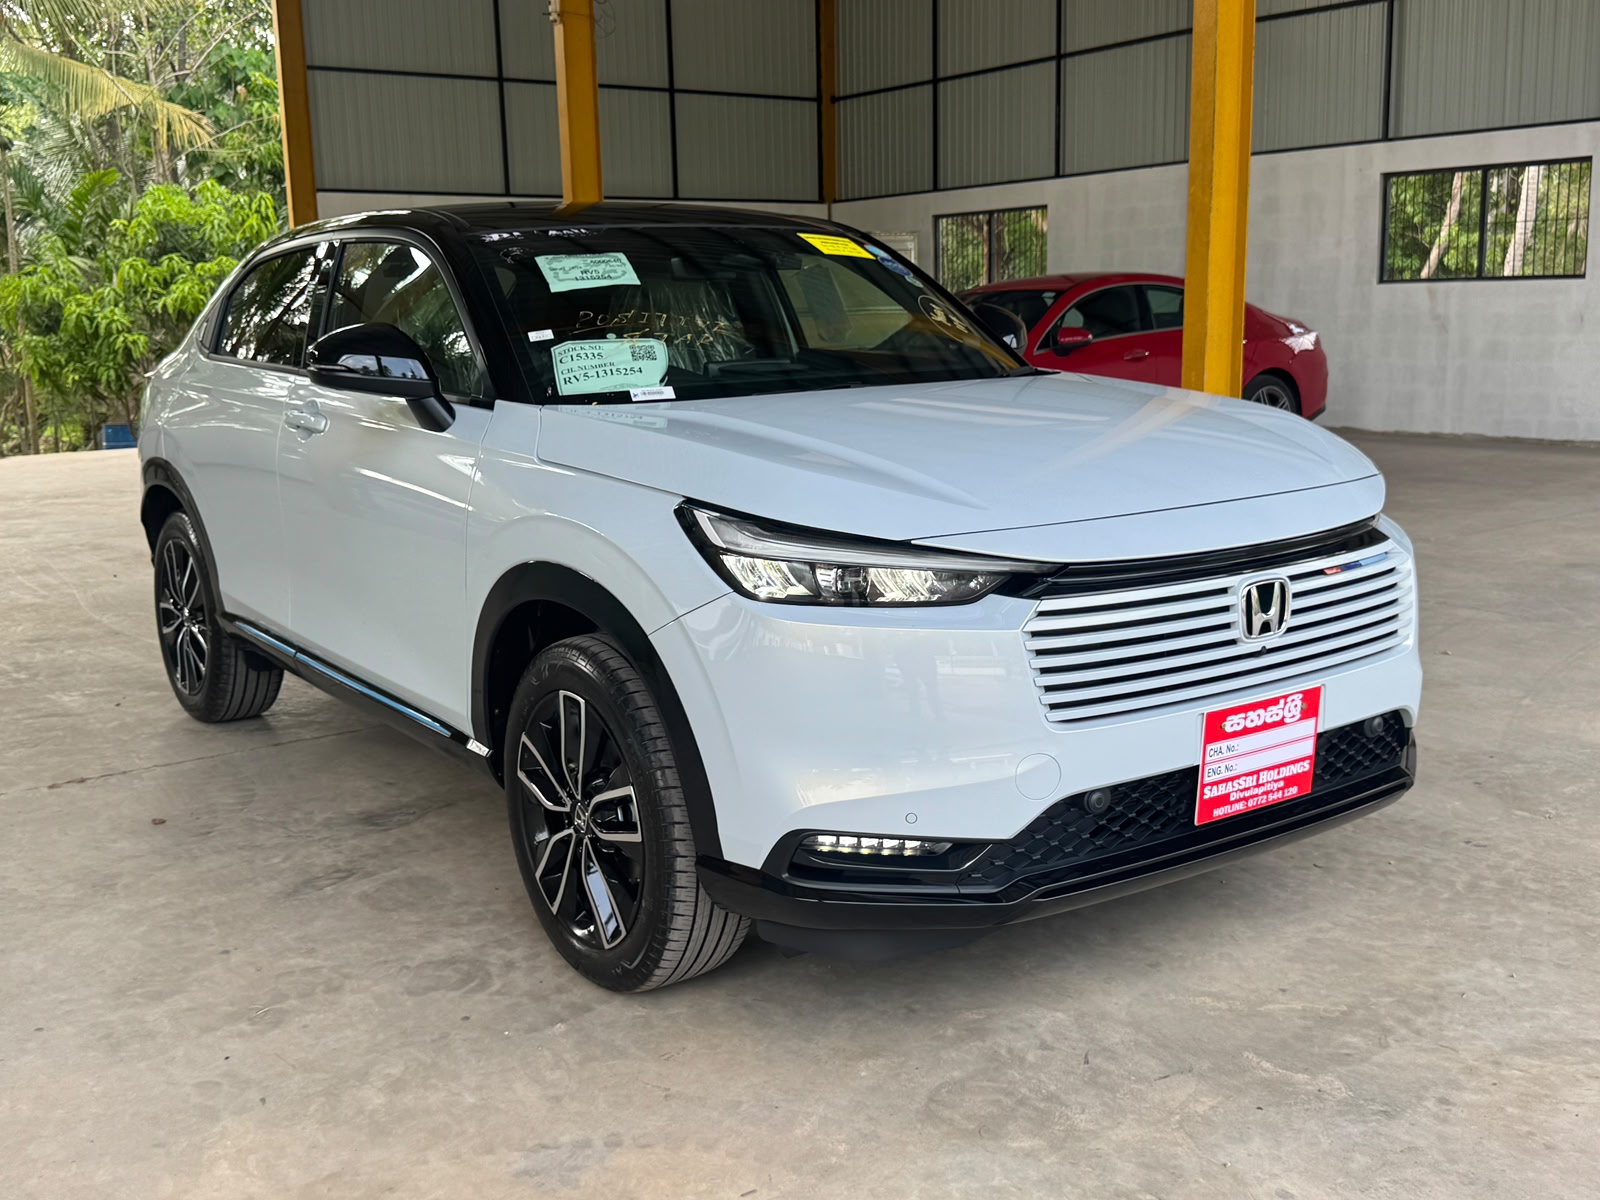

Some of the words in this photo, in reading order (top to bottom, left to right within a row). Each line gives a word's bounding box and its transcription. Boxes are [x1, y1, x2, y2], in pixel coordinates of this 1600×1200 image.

[558, 345, 587, 355] STOCK
[559, 352, 604, 364] C15335
[563, 367, 643, 385] RV5-1315254
[1208, 745, 1225, 758] CHA.
[1207, 765, 1222, 778] ENG.
[1259, 760, 1311, 784] HOLDINGS
[1229, 781, 1284, 801] Divulapitiya
[1213, 801, 1247, 817] HOTLINE:
[1248, 795, 1267, 808] 0772
[1284, 786, 1298, 797] 120
